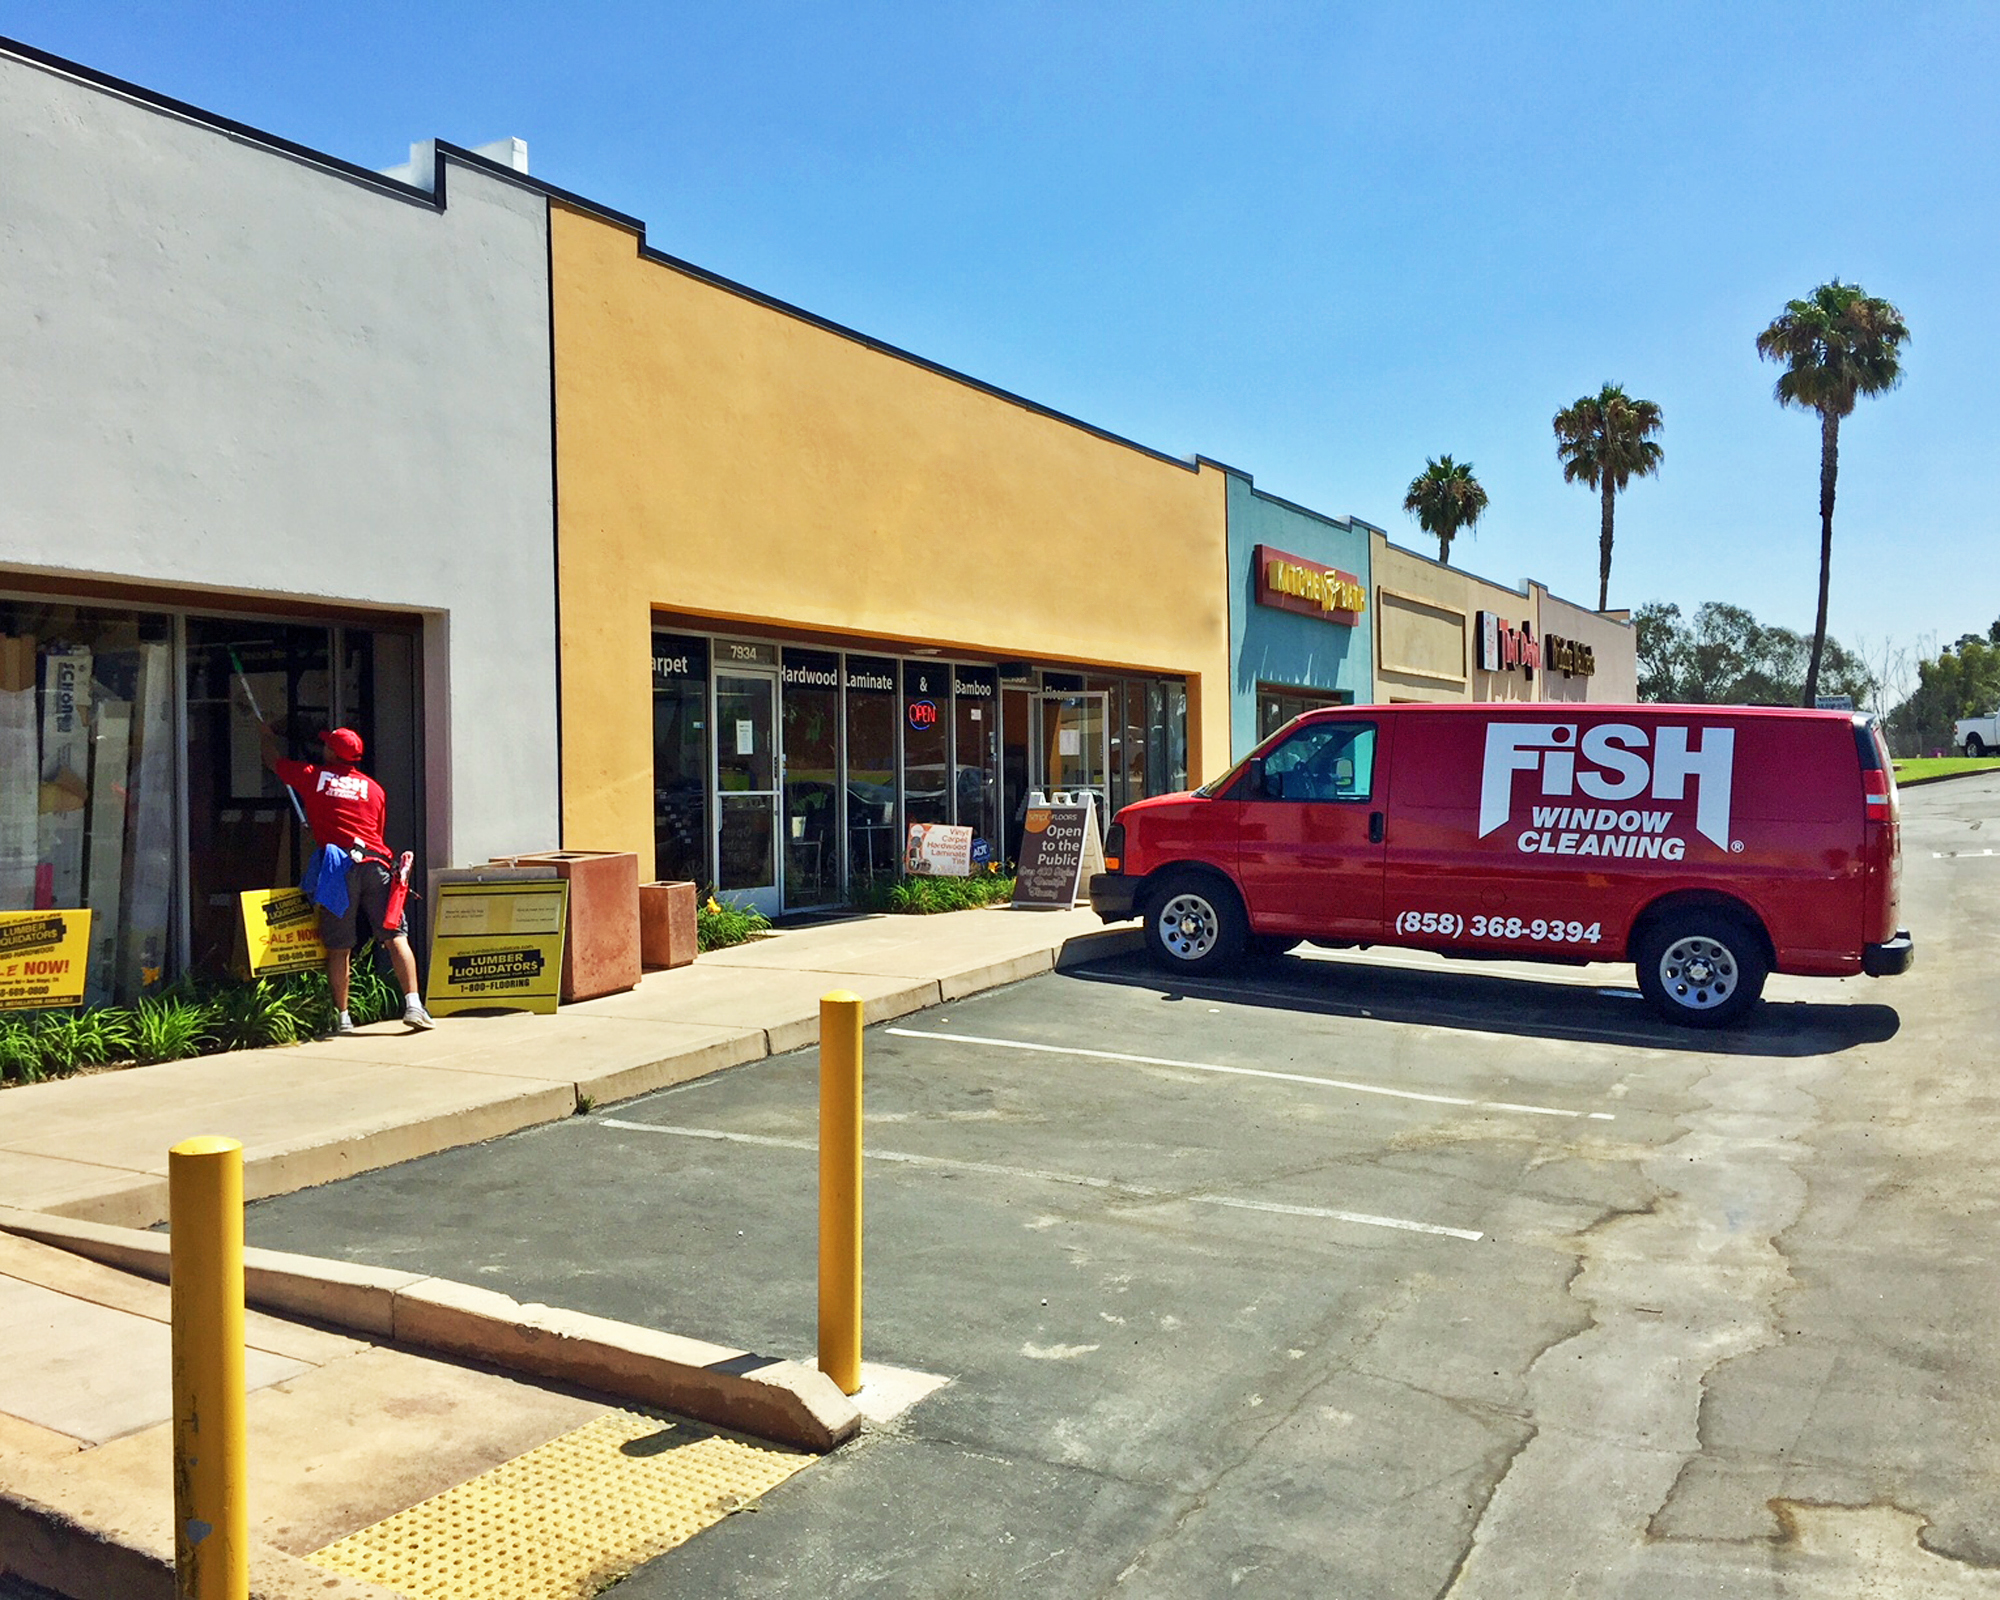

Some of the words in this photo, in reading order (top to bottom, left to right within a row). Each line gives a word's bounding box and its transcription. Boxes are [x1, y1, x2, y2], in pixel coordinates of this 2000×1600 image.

[730, 646, 757, 660] 7934
[652, 656, 688, 677] arpet
[845, 671, 893, 690] Laminate
[920, 677, 928, 692] &
[955, 679, 992, 696] Bamboo
[910, 704, 936, 723] OPEN
[1532, 806, 1673, 833] WINDOW
[941, 835, 968, 843] Carpet
[949, 828, 969, 836] Vinyl
[1046, 825, 1081, 839] Open
[927, 842, 967, 850] Hardwood
[973, 845, 988, 857] ADT
[1042, 840, 1056, 851] to
[1058, 839, 1080, 851] the
[1517, 831, 1686, 860] CLEANING
[931, 849, 966, 857] Laminate
[1037, 854, 1078, 866] Public
[952, 857, 966, 865] Tile
[3, 922, 46, 937] LUMBER
[1395, 911, 1464, 938] (858)
[1470, 915, 1602, 944] 368-9394
[258, 932, 294, 946] SALE
[470, 953, 524, 966] LUMBER
[24, 959, 70, 976] NOW!
[460, 978, 530, 992] 1-800-FLOORING
